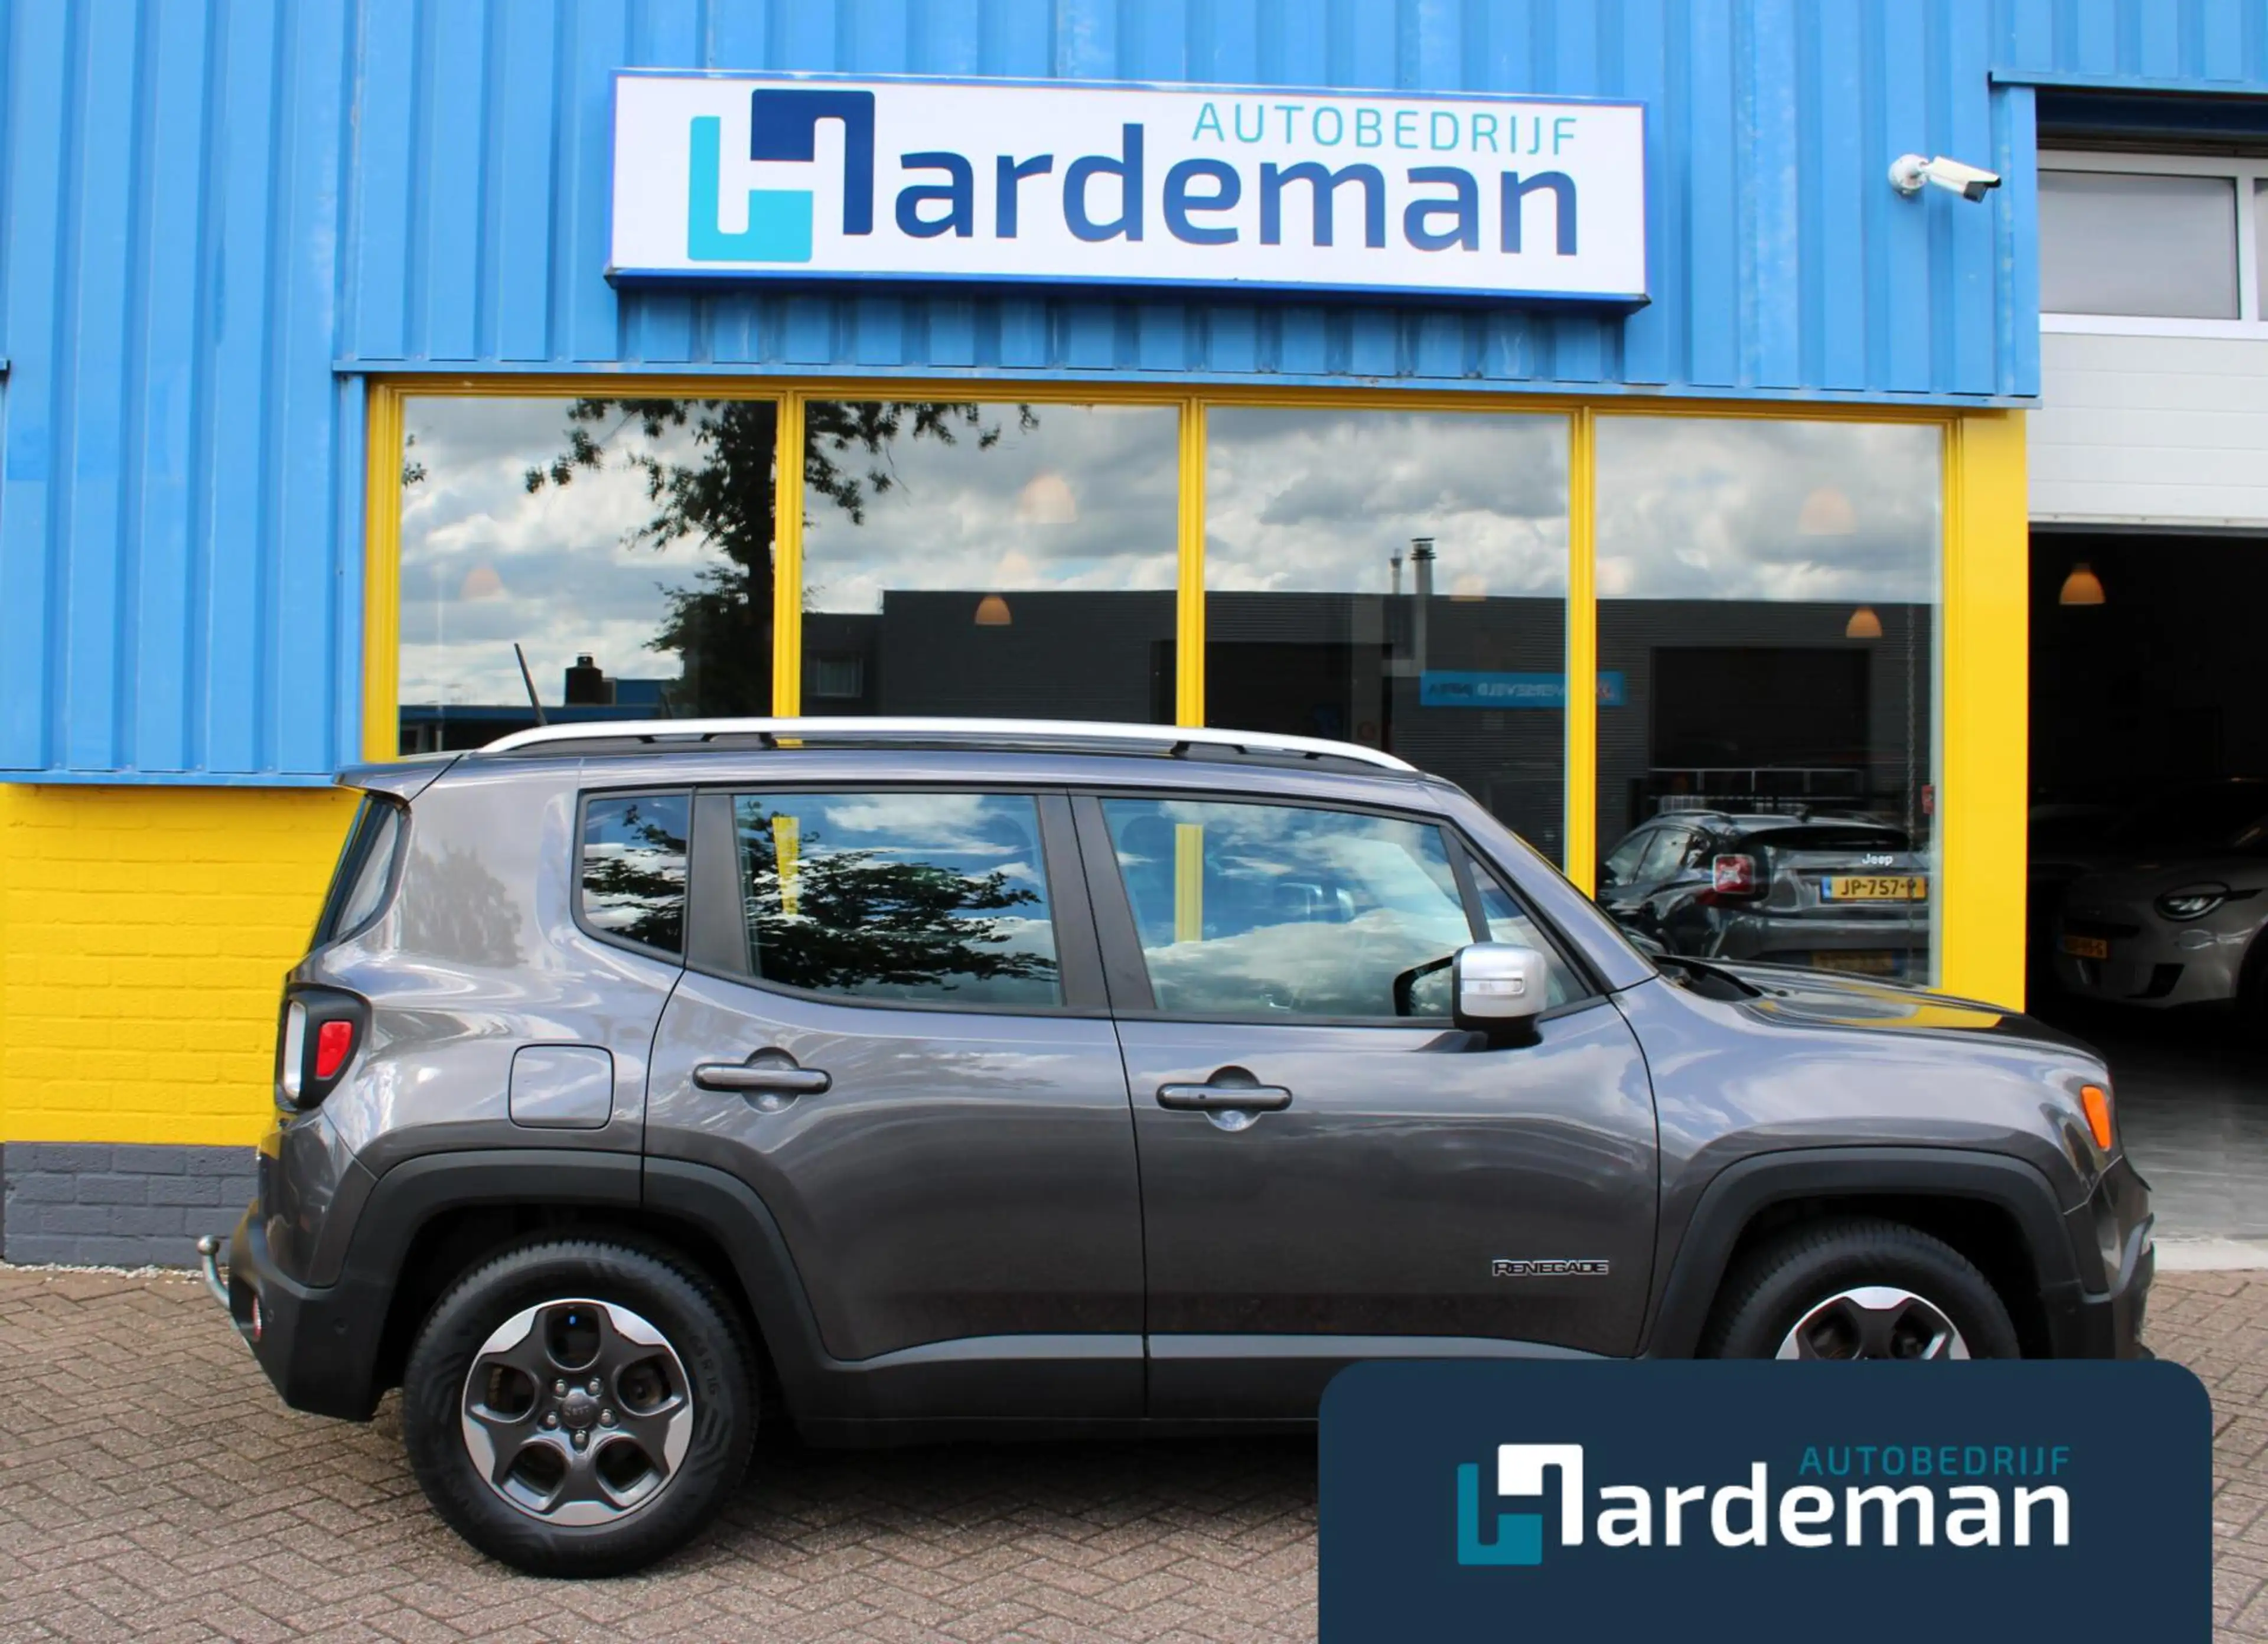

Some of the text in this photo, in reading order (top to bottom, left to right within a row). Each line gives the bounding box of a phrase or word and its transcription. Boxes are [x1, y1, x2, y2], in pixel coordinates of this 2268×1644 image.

[1192, 102, 1576, 155] AUTOBEDRIJF
[687, 87, 1578, 263] Hardeman
[1862, 853, 1894, 866] Jeep
[1492, 1260, 1609, 1277] RENEGADE
